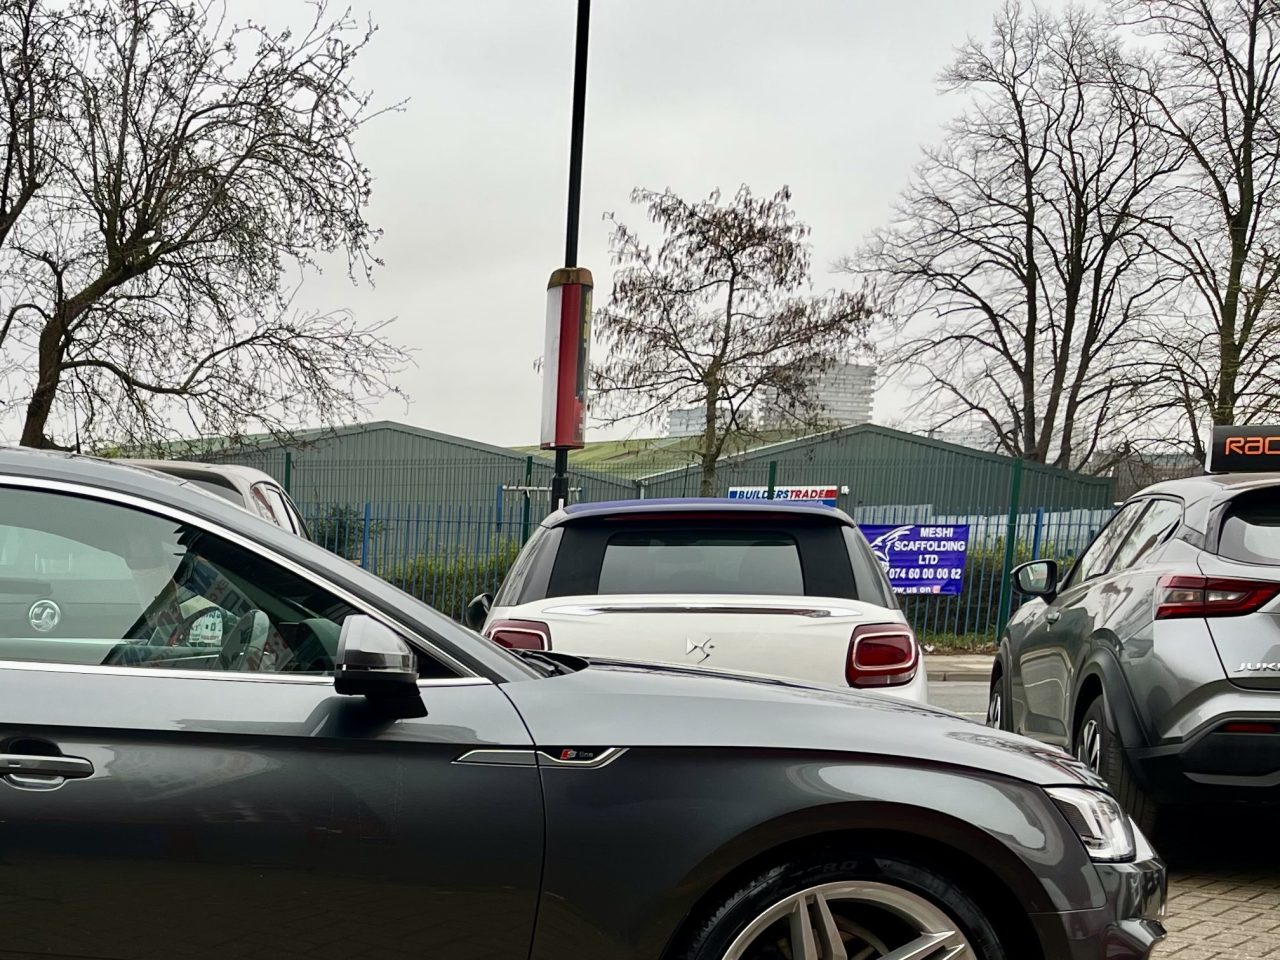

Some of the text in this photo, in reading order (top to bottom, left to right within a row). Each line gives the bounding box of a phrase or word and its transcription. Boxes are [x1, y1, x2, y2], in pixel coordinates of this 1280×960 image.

[920, 527, 954, 538] MESHI
[893, 540, 966, 552] SCAFFOLDING
[918, 554, 939, 565] LTD
[889, 568, 962, 580] 074 60 00 00 82
[906, 586, 917, 594] us
[920, 586, 932, 594] on
[1233, 662, 1280, 672] JUK
